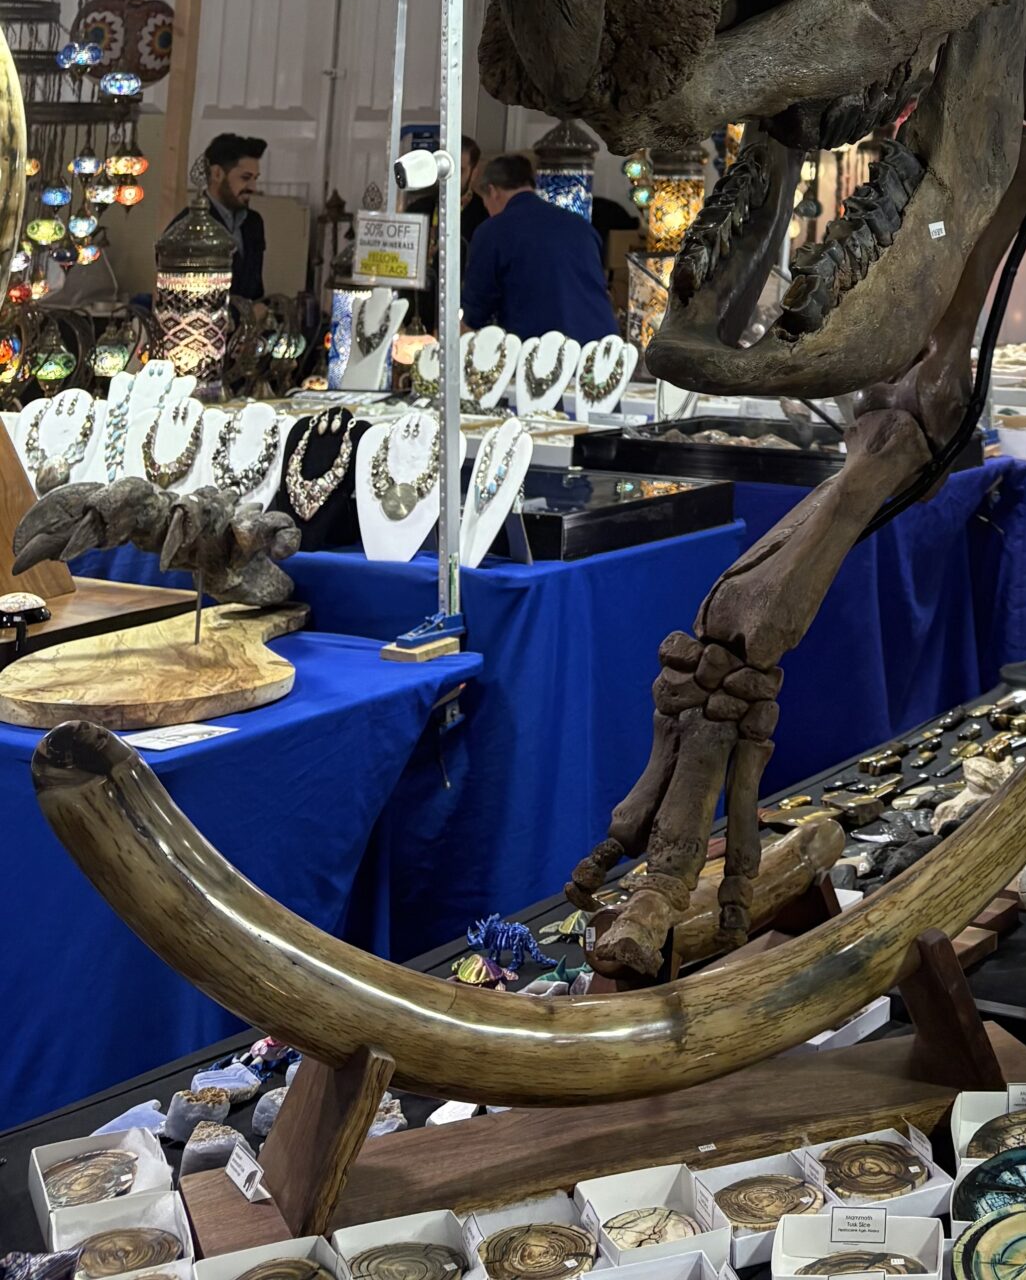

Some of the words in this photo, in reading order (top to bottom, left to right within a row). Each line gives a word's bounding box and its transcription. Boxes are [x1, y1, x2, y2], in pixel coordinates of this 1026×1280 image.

[364, 222, 384, 238] 50%
[386, 224, 411, 239] OFF
[382, 241, 414, 250] MINERALS
[385, 263, 408, 276] TAGS
